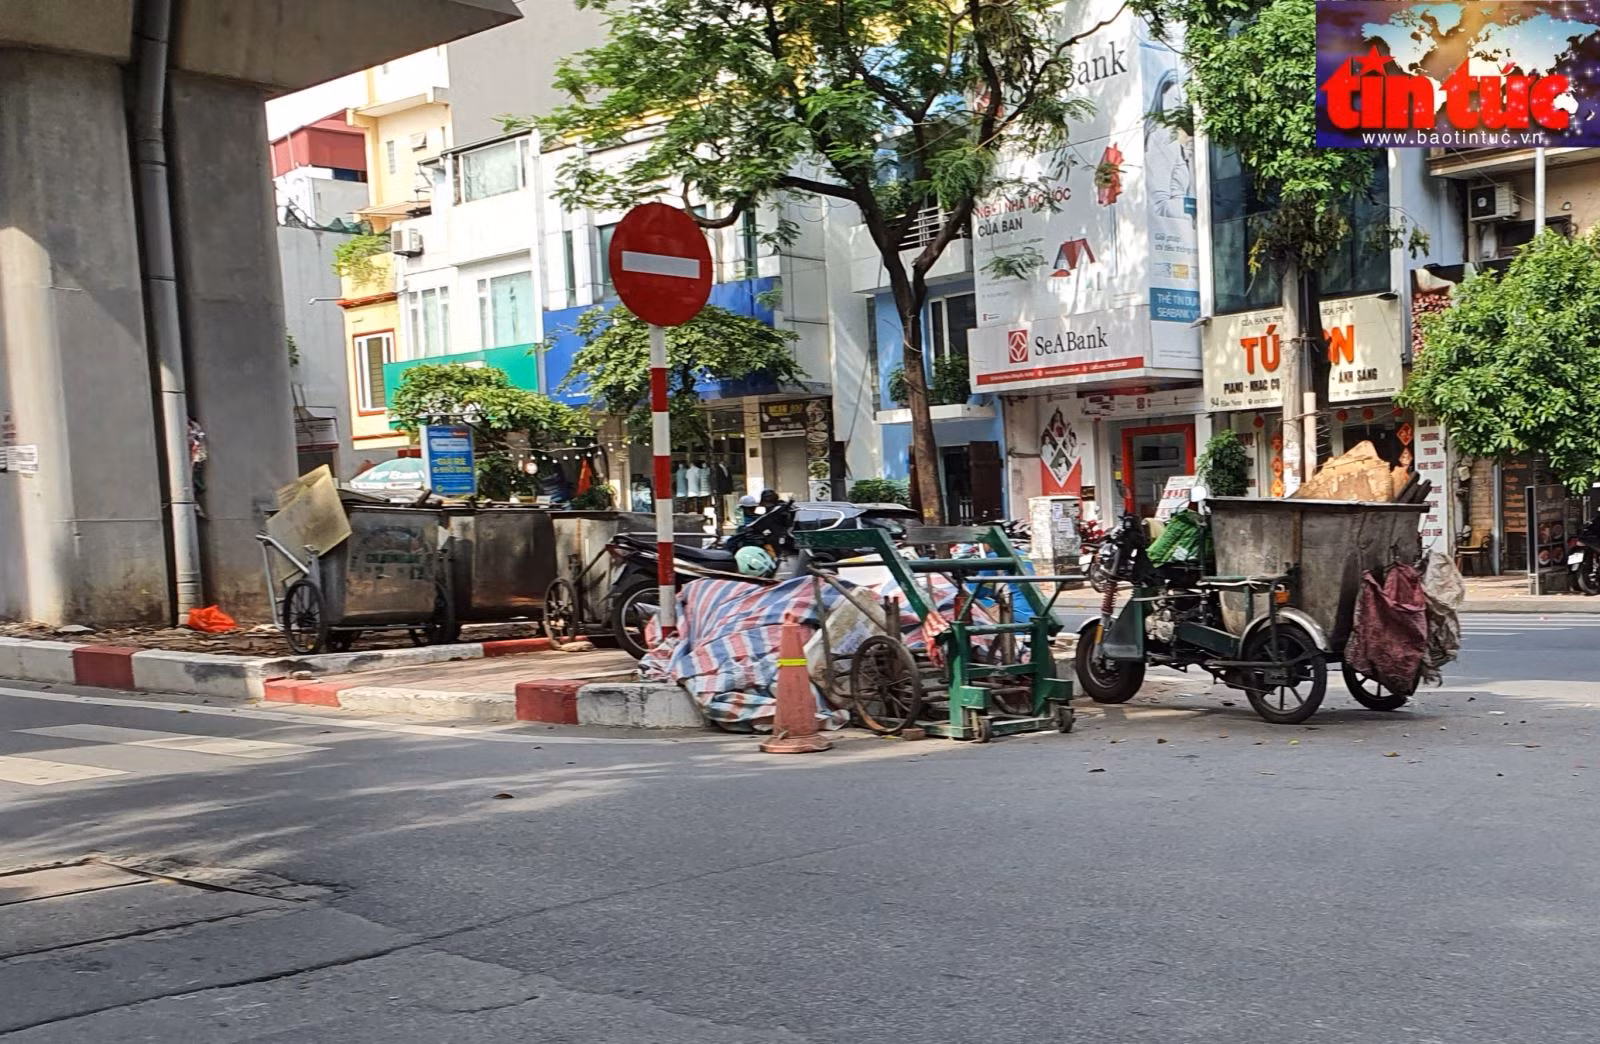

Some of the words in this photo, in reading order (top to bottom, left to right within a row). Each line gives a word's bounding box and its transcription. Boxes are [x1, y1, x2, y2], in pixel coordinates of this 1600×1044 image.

[978, 219, 999, 238] CỦA
[1001, 217, 1023, 235] BẠN
[1034, 326, 1109, 356] SeABank
[1240, 324, 1281, 375] TÚ
[1357, 367, 1378, 382] SÁNG
[1224, 382, 1244, 395] PIANO
